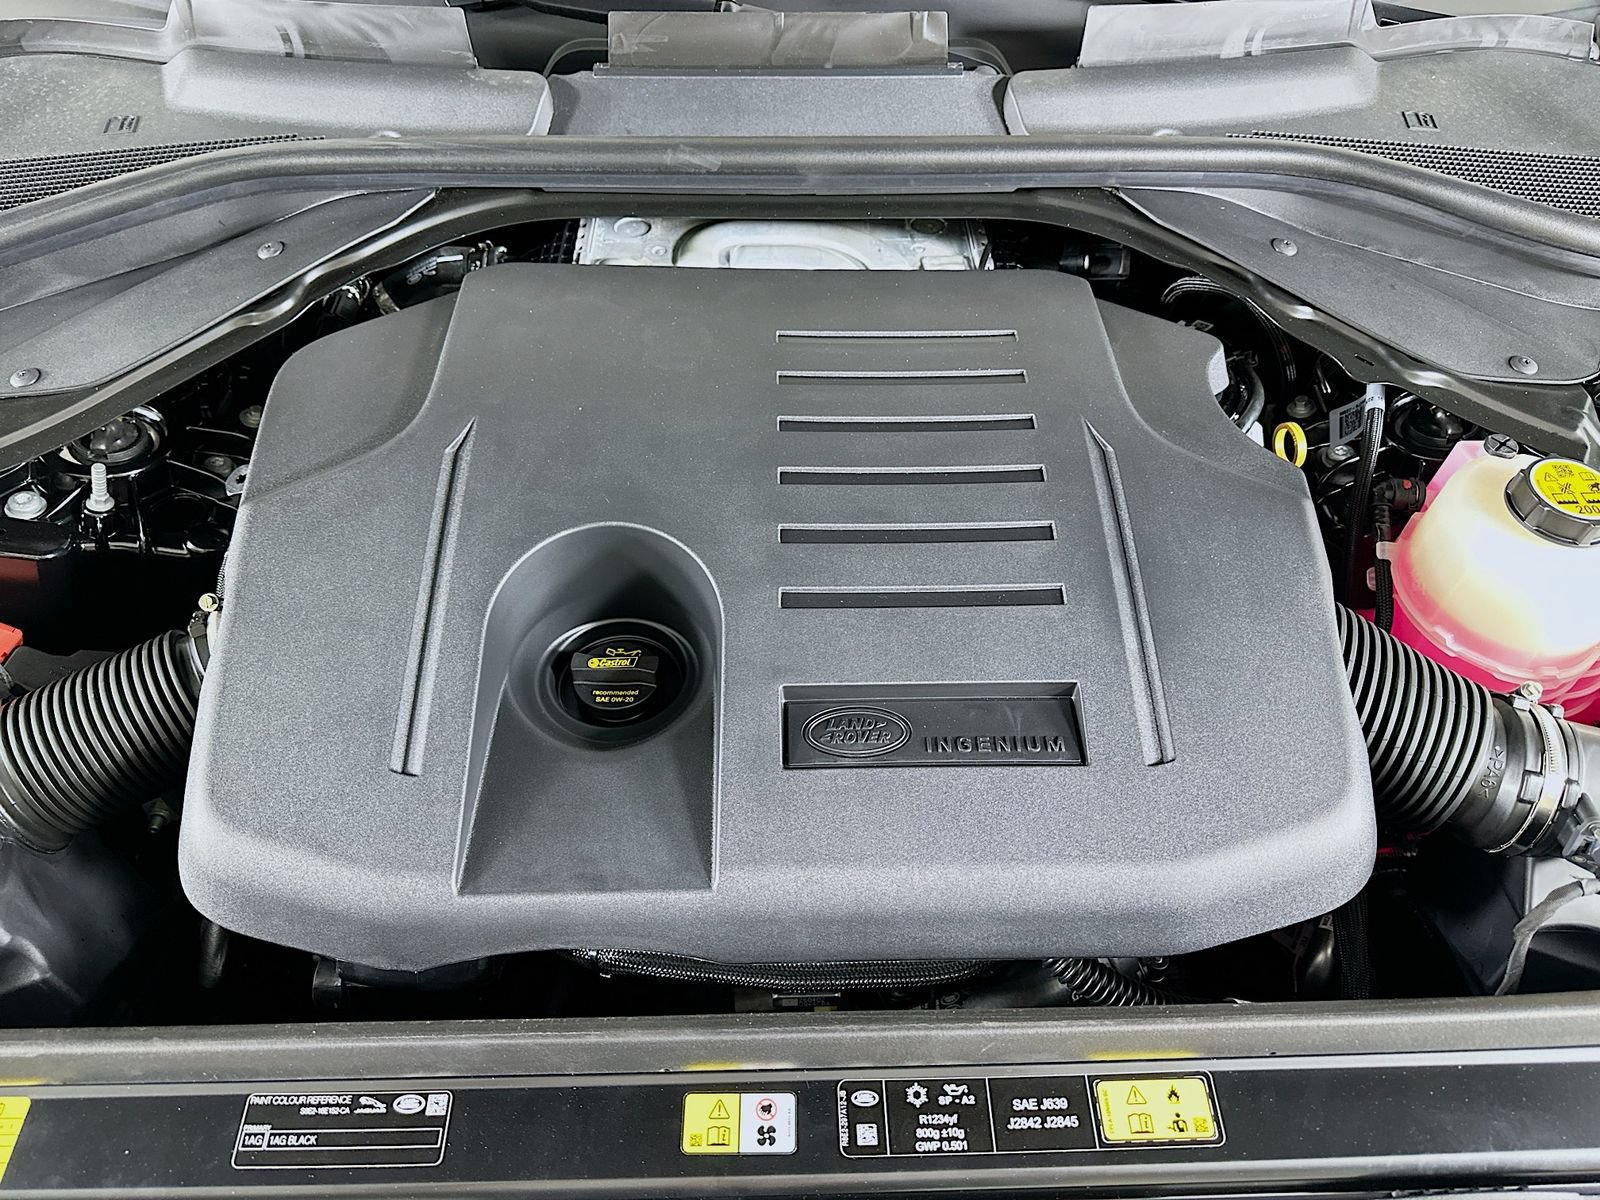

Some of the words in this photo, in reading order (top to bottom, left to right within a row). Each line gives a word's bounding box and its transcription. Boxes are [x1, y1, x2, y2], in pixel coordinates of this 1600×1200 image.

[599, 658, 631, 666] Castrol
[826, 718, 876, 731] LAND
[830, 731, 892, 744] ROVER
[924, 736, 1067, 753] INGENIUM
[250, 1095, 274, 1105] PAINT
[272, 1095, 307, 1105] COLOUR
[306, 1094, 353, 1105] REFERENCE
[1012, 1098, 1039, 1111] SAE
[1040, 1097, 1069, 1110] J639
[918, 1113, 959, 1126] R1234yf
[1007, 1116, 1042, 1130] J2842
[1043, 1115, 1080, 1128] J2845
[244, 1134, 264, 1146] 1AG
[269, 1134, 288, 1146] 1AG
[287, 1134, 318, 1146] BLACK
[915, 1127, 940, 1140] 800g
[915, 1141, 941, 1152] GWP
[941, 1140, 968, 1151] 0.501
